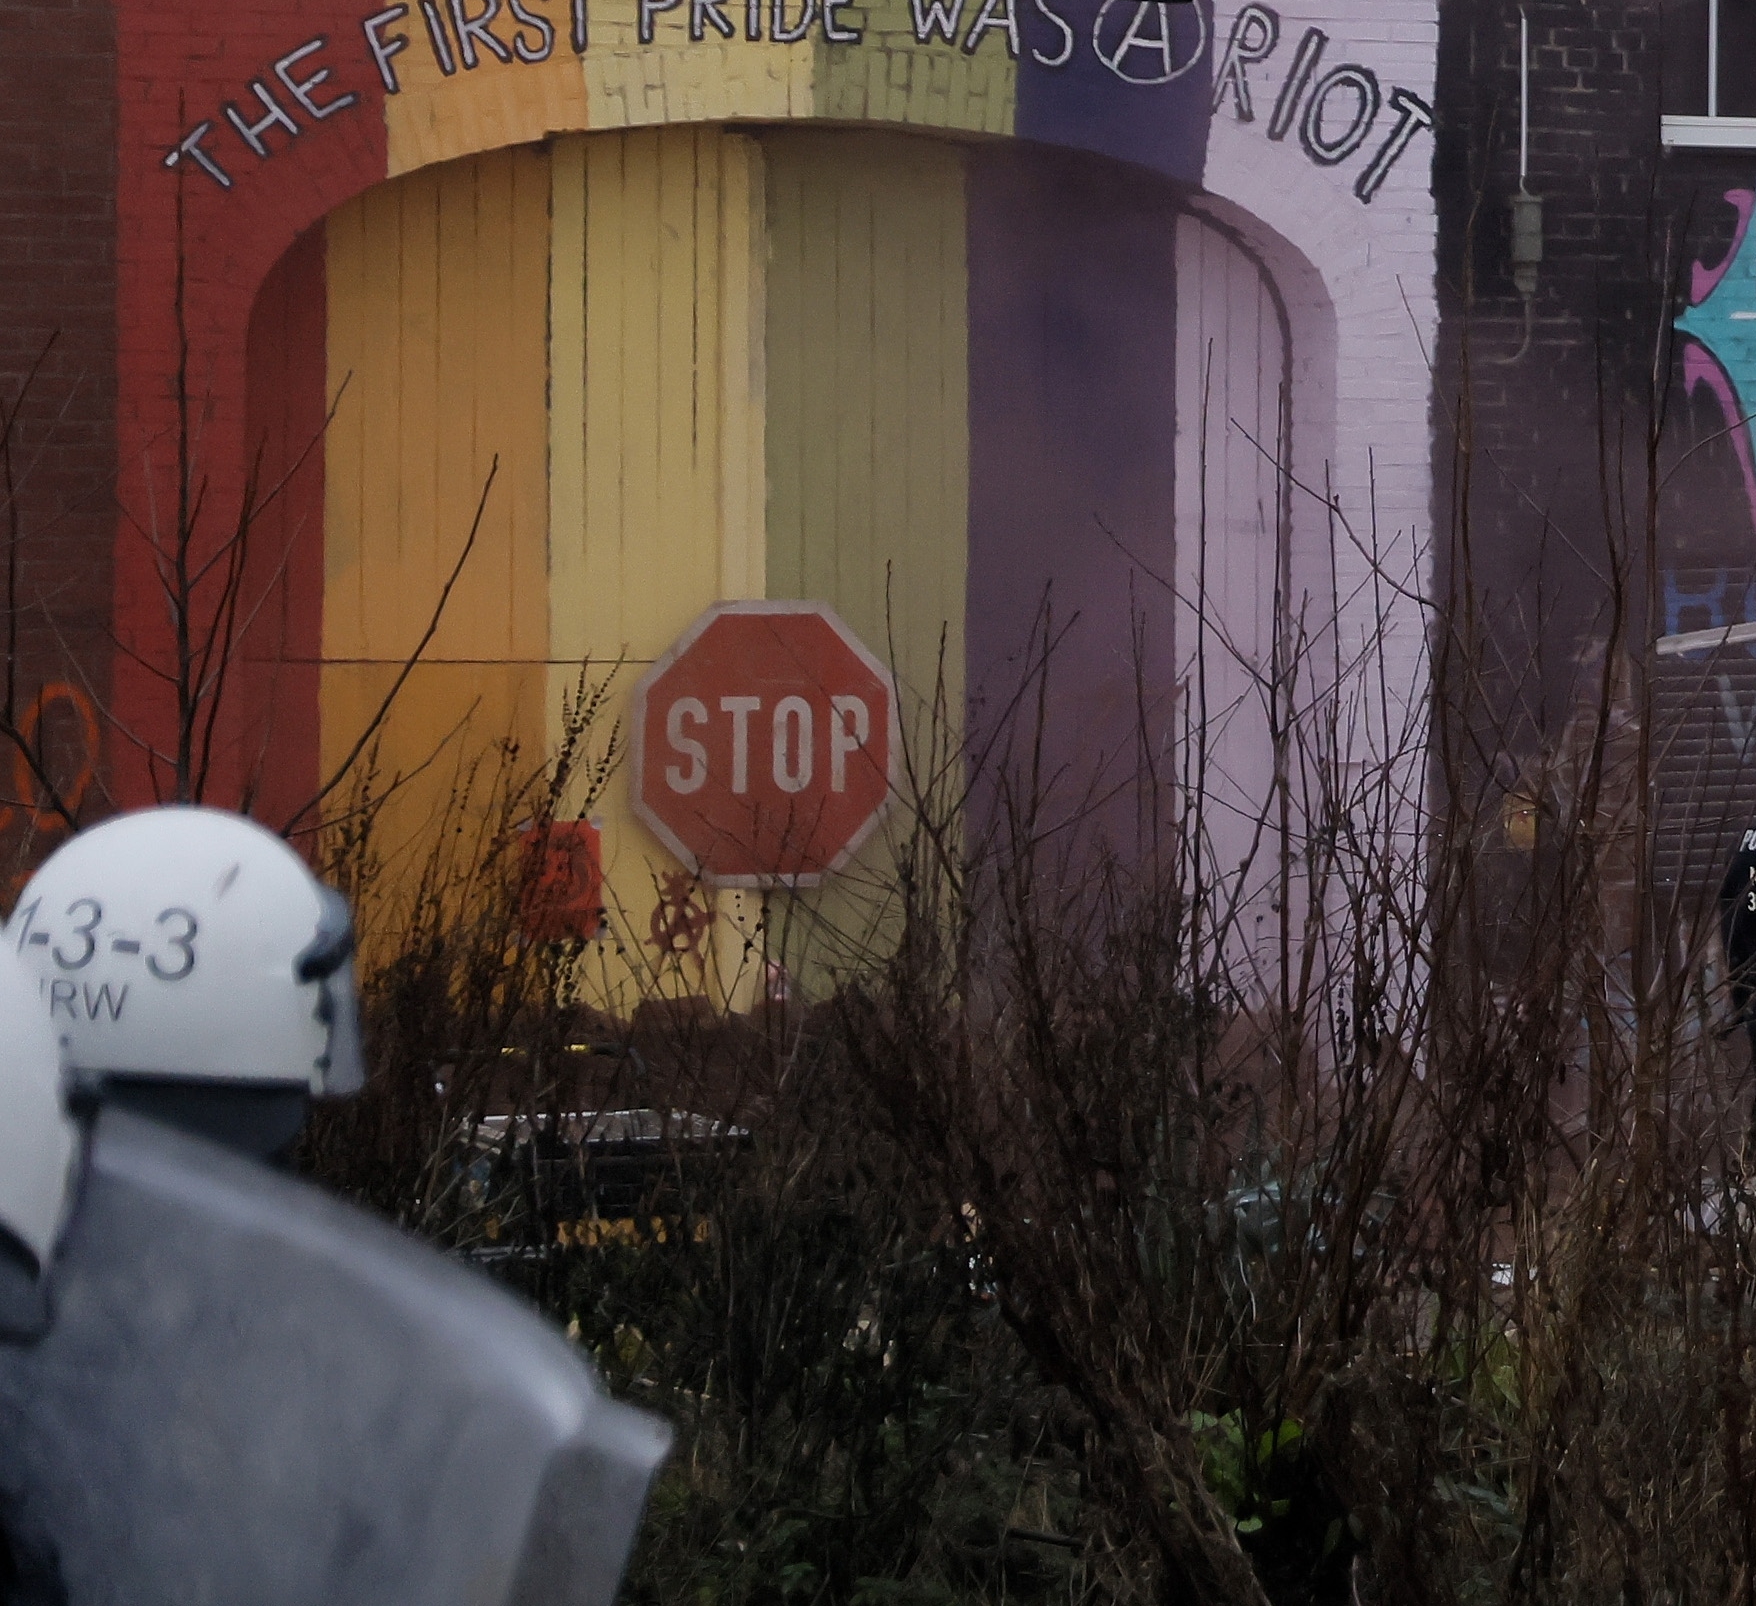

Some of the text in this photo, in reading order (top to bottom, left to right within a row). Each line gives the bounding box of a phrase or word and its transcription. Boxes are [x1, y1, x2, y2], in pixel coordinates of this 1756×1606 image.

[164, 38, 358, 189] THE
[1211, 0, 1435, 205] RIOT
[665, 695, 870, 794] STOP
